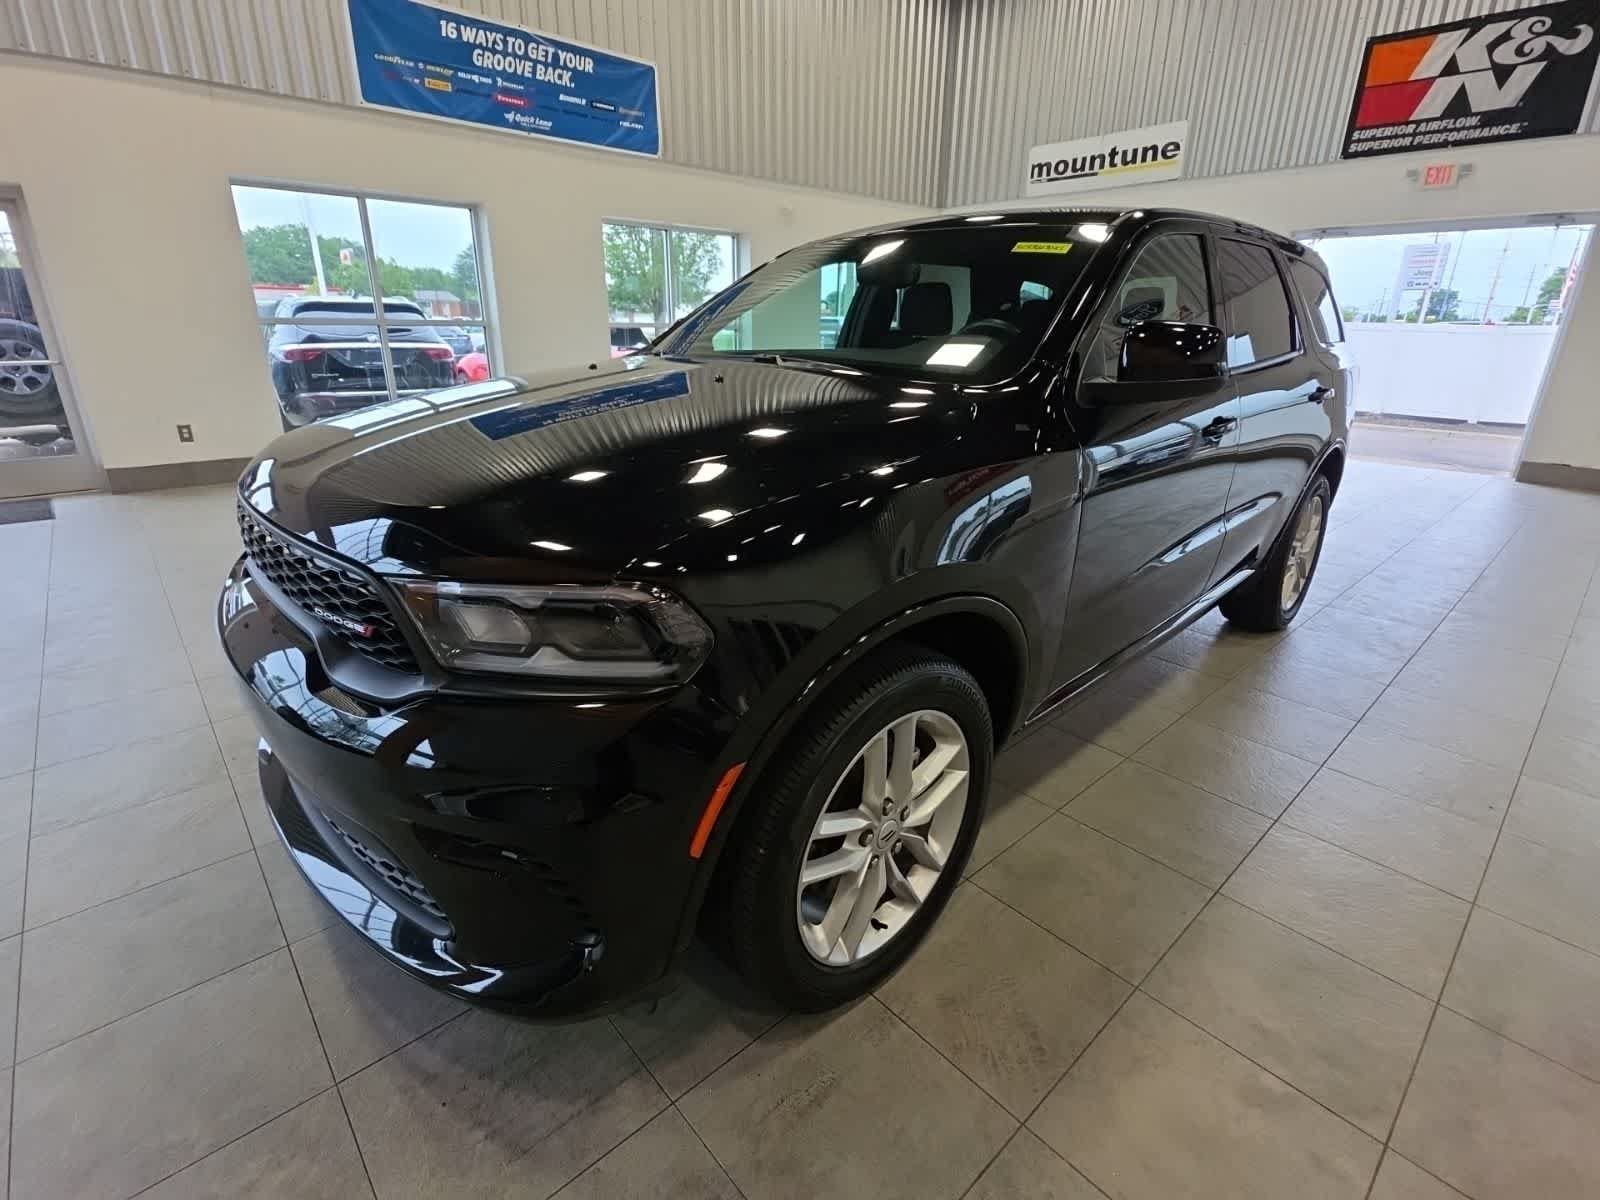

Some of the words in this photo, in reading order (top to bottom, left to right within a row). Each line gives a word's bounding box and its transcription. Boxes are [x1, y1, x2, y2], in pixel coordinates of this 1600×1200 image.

[440, 20, 457, 39] 16
[460, 25, 504, 51] WAYS
[506, 36, 525, 56] TO
[527, 42, 555, 63] GET
[558, 50, 594, 74] YOUR
[472, 49, 533, 78] GROOVE
[536, 63, 575, 88] BACK.
[515, 113, 535, 125] Quick
[1351, 122, 1417, 140] SUPERIOR
[1417, 115, 1481, 133] AIRFLOW.
[1349, 136, 1412, 153] SUPERIOR
[1030, 140, 1181, 179] mountune
[1424, 165, 1456, 186] EXIT
[314, 607, 366, 633] DODGE
